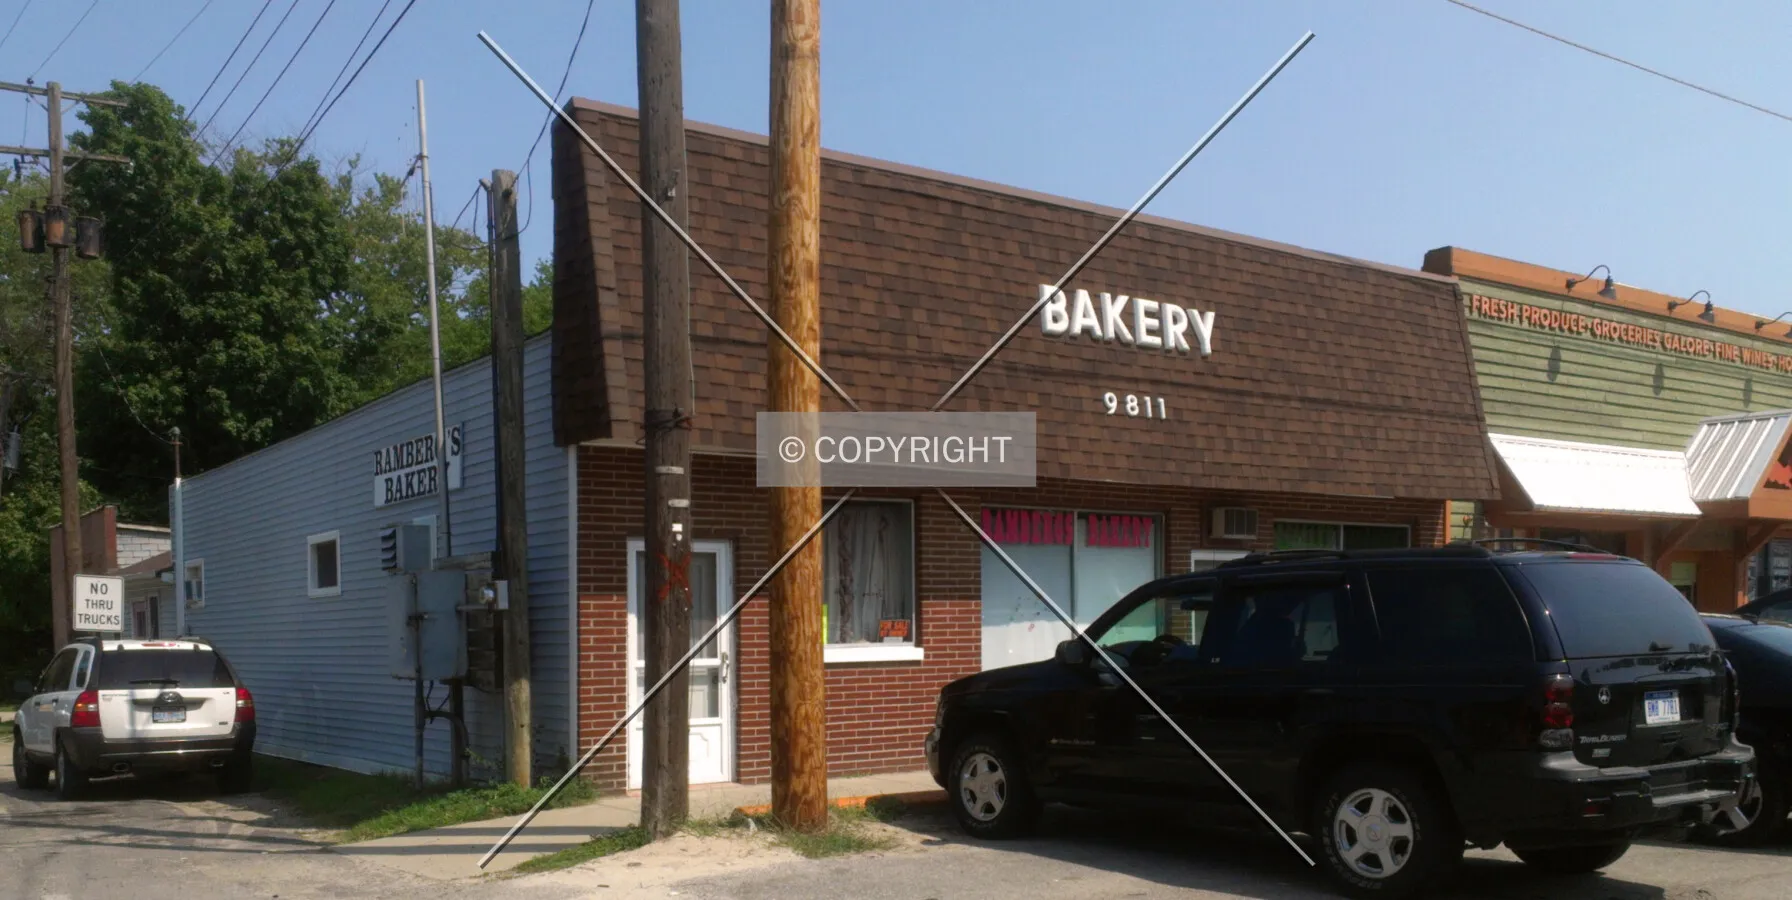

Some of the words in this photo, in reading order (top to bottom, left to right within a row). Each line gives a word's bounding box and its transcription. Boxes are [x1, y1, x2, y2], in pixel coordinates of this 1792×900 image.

[1039, 284, 1215, 356] BAKERY
[1472, 294, 1517, 321] FRESH
[1522, 304, 1586, 333] PRODUCE
[1593, 317, 1660, 347] GROCERIES
[1663, 331, 1710, 356] GALORE
[1715, 342, 1739, 363] FINE
[1742, 346, 1773, 369] WINES
[1103, 391, 1166, 419] 9811
[374, 426, 460, 476] RAMBER'S
[384, 461, 449, 504] BAKER
[85, 599, 113, 610] THRU
[90, 583, 108, 595] NO
[78, 614, 119, 625] TRUCKS
